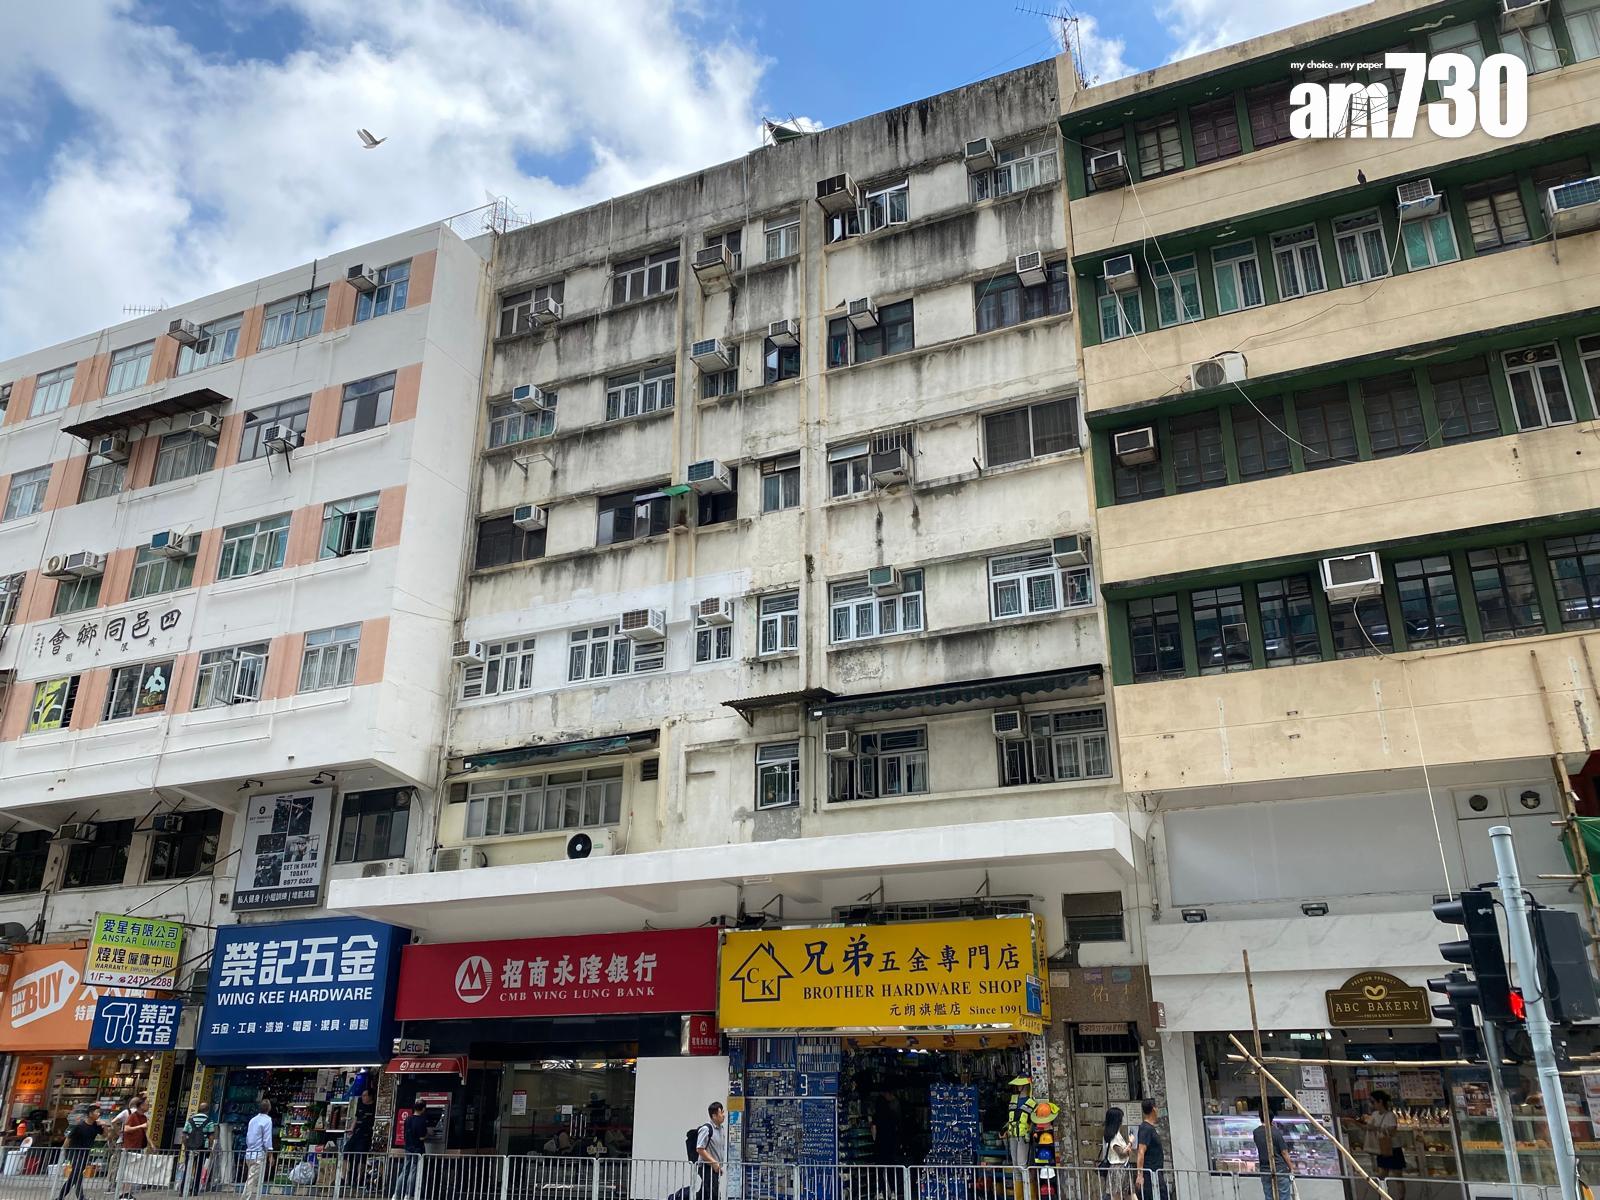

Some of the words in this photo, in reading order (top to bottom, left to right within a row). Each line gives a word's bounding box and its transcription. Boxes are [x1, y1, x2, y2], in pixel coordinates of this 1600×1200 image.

[102, 919, 179, 941] 愛星有限公司
[101, 933, 137, 945] ANSTAR
[142, 939, 177, 949] LIMITED
[219, 934, 379, 987] 榮記五金
[800, 933, 1020, 977] 兄弟五金專門店
[95, 963, 128, 971] WARRANTY
[500, 951, 658, 989] 招商永隆銀行
[90, 972, 104, 980] 1/F
[127, 974, 149, 985] 2470
[150, 977, 172, 987] 2288
[24, 968, 64, 1016] BUY
[216, 992, 255, 1006] WING
[258, 990, 286, 1004] KEE
[288, 987, 373, 1003] HARDWARE
[499, 991, 527, 1002] CMB
[533, 990, 568, 1000] WING
[573, 988, 610, 999] LUNG
[616, 986, 655, 997] BANK
[803, 984, 875, 1000] BROTHER
[881, 981, 972, 997] HARDWARE
[979, 979, 1022, 994] SHOP
[139, 1003, 177, 1025] 榮記
[889, 1001, 961, 1017] 元朗旗艦店
[969, 1005, 997, 1015] Since
[1000, 1004, 1022, 1015] 1991
[1335, 1002, 1360, 1013] ABC
[1367, 1000, 1419, 1012] BAKERY
[134, 1024, 172, 1045] 五金
[211, 1023, 229, 1035] 五金
[237, 1022, 256, 1034] 工具
